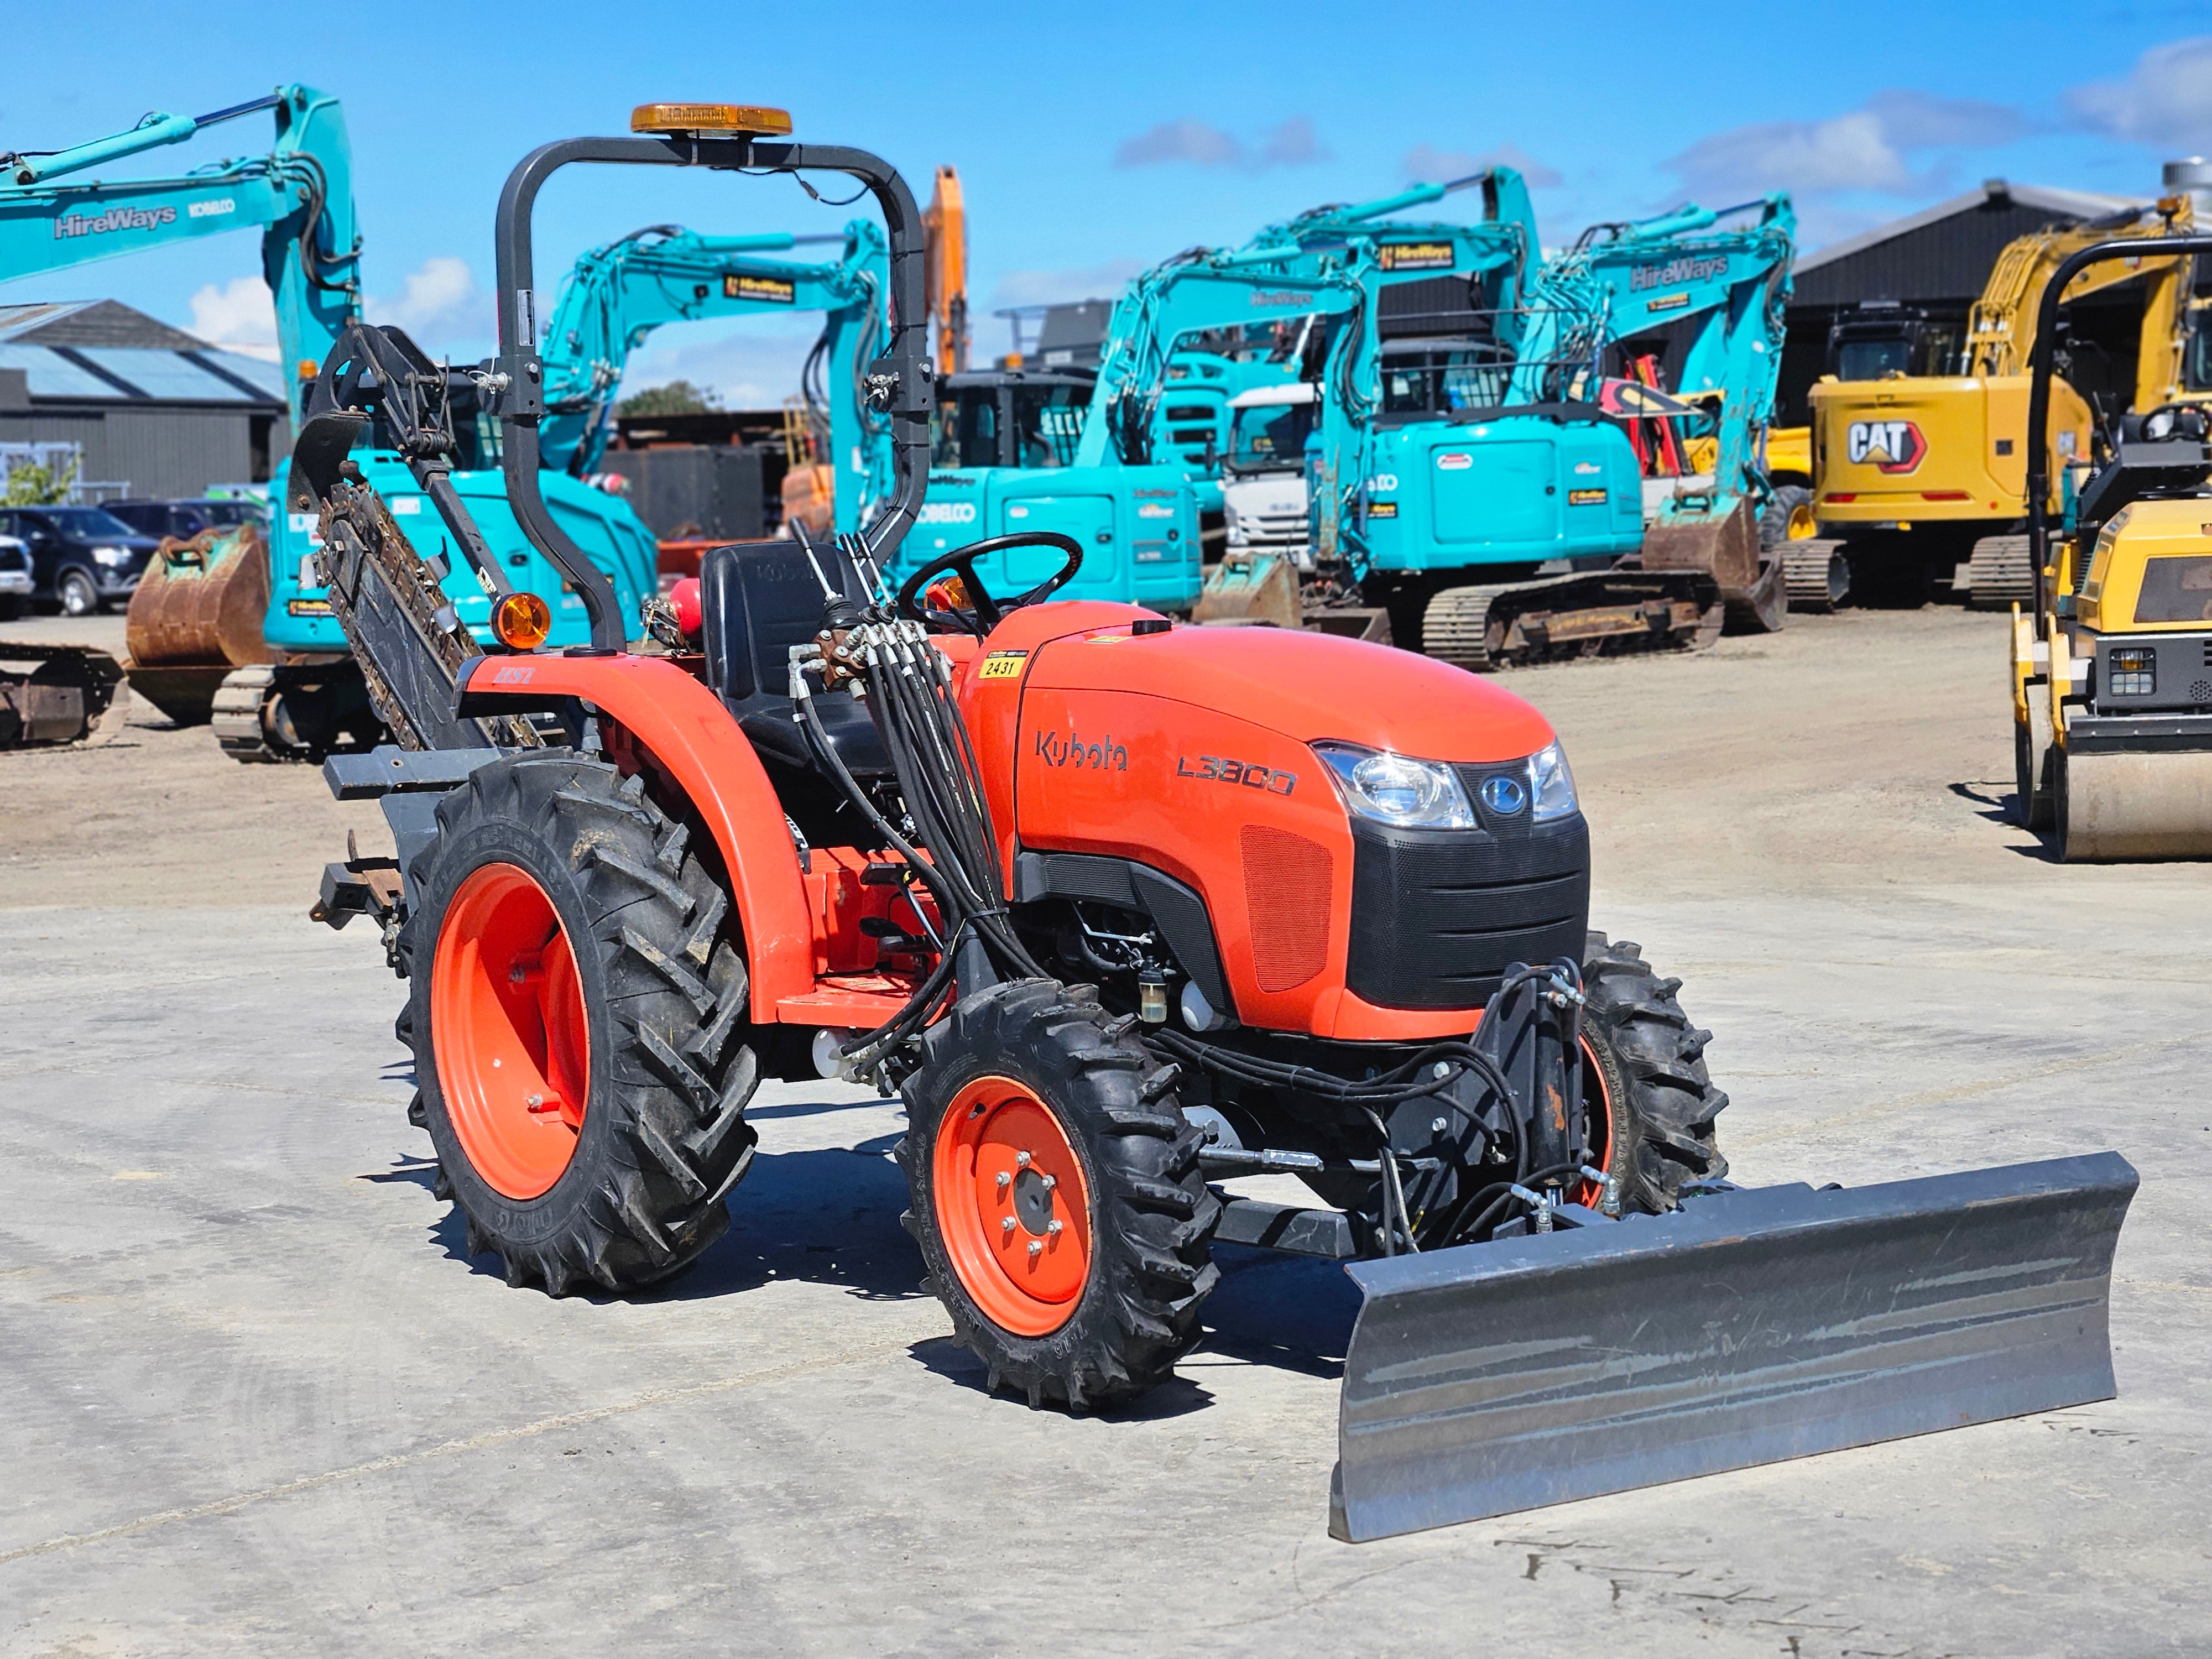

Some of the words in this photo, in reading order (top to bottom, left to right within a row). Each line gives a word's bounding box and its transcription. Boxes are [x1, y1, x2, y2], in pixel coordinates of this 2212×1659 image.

[53, 206, 177, 239] HireWays
[1630, 255, 1728, 291] HireWays
[1850, 422, 1907, 462] CAT
[916, 503, 976, 524] OBELCO
[985, 661, 1015, 675] 2431
[1036, 731, 1127, 771] Kubota
[1177, 755, 1298, 796] L3800
